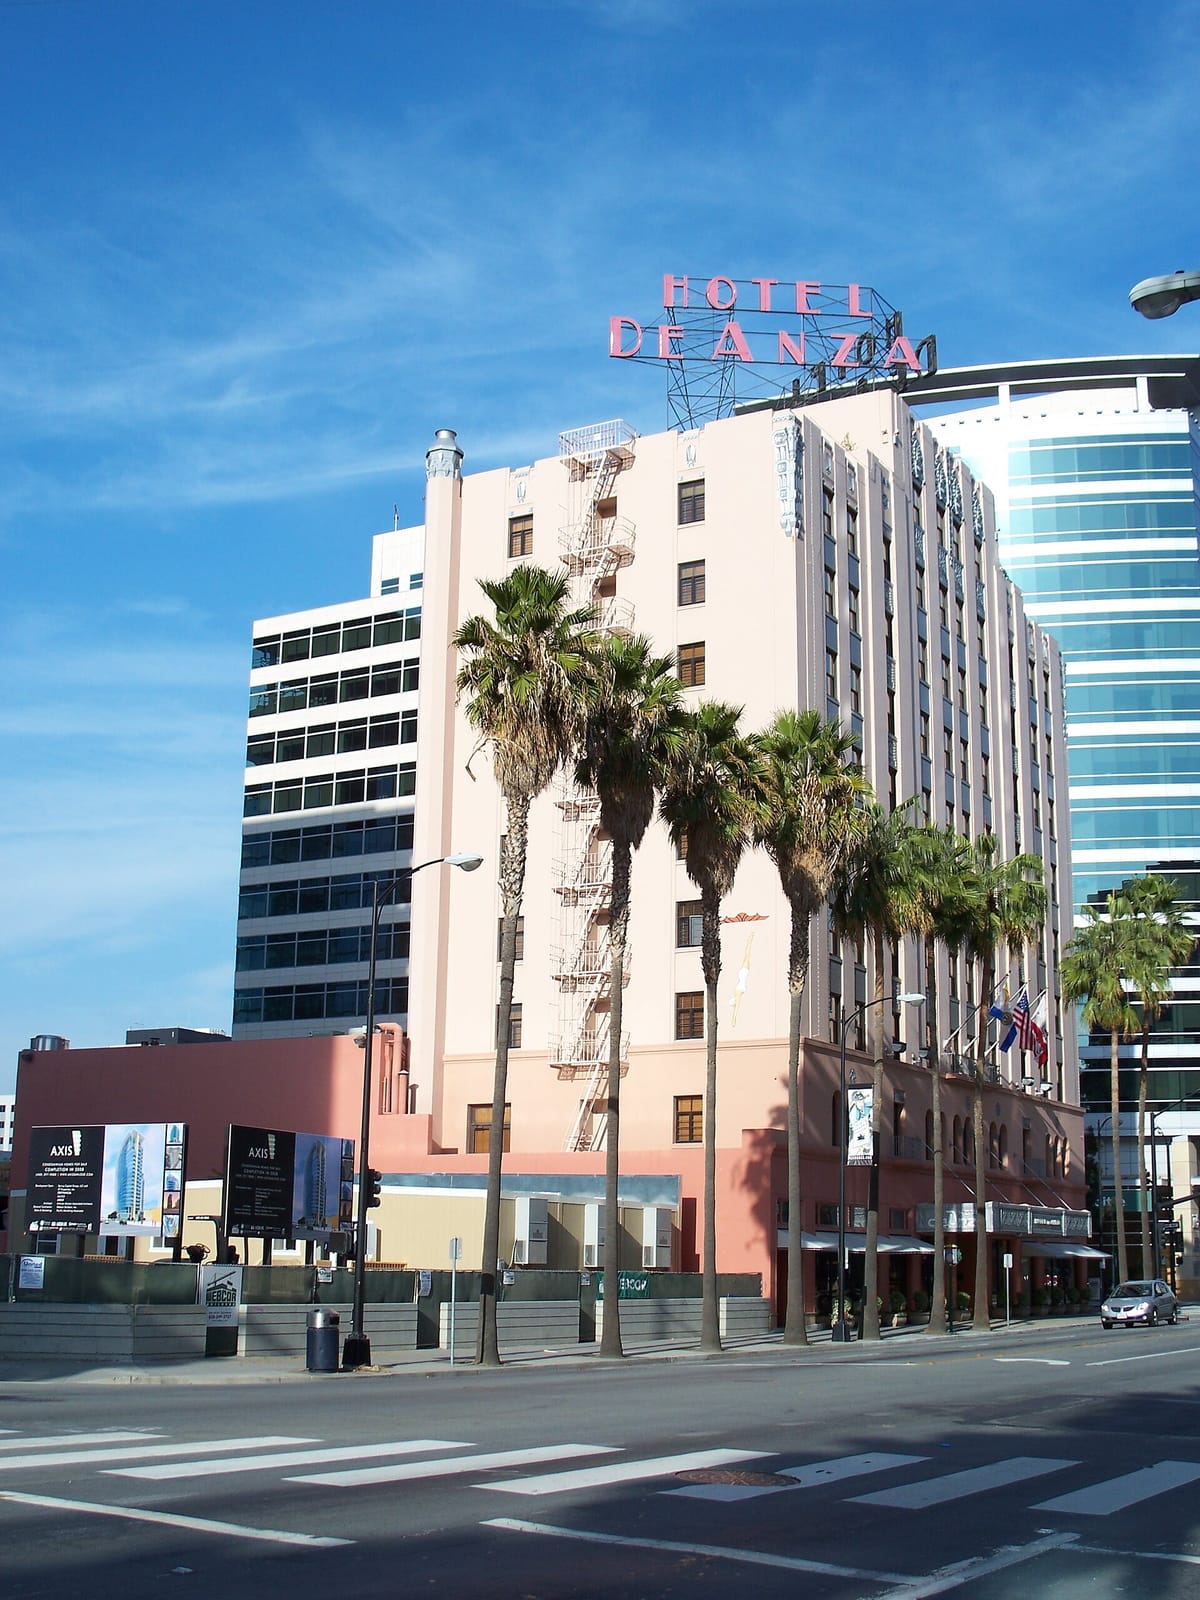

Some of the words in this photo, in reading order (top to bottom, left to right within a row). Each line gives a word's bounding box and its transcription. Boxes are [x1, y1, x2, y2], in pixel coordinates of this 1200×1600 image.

[663, 273, 873, 317] HOTEL
[609, 316, 685, 360] DE
[711, 321, 922, 371] ANZA
[50, 1145, 73, 1157] AXIS
[248, 1147, 269, 1159] AXIS
